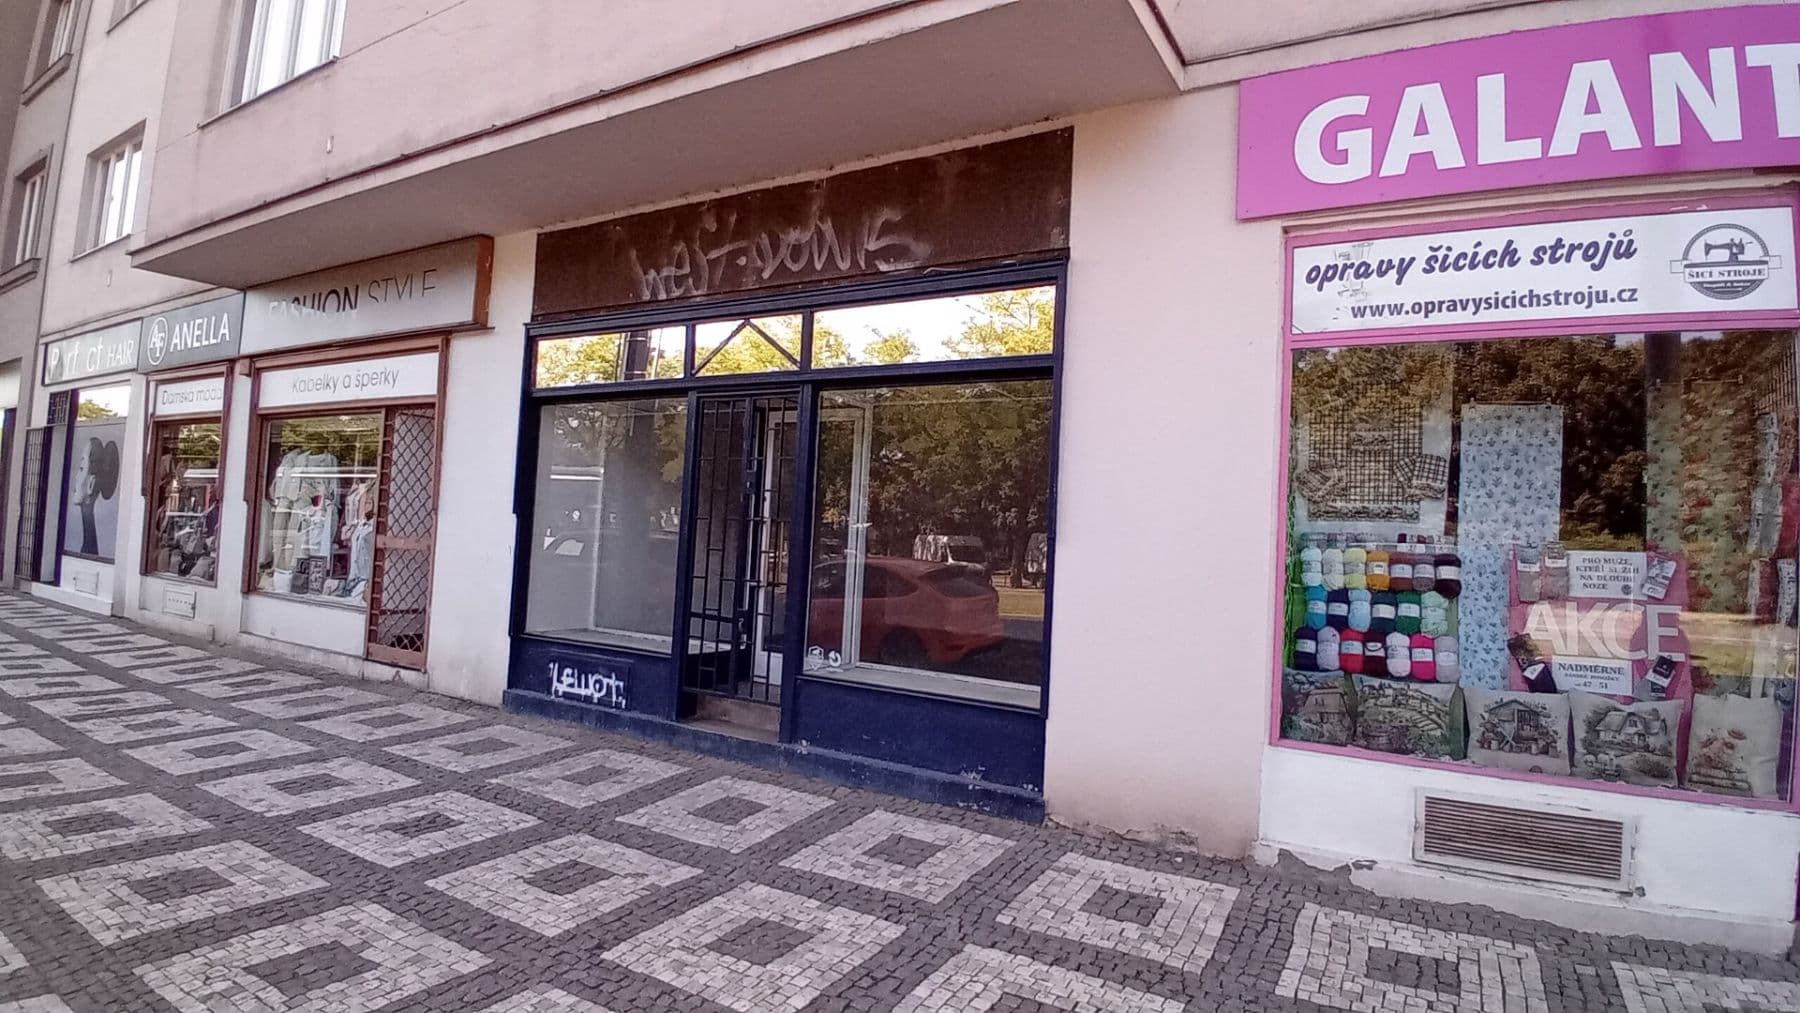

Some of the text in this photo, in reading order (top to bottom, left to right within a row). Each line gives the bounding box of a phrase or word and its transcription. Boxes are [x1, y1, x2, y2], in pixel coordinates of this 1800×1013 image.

[1293, 43, 1800, 184] GALANT
[1305, 228, 1638, 292] opravy šicích strojů
[1718, 267, 1766, 278] STROJE
[1350, 286, 1639, 320] www.opravysicichstroju.cz
[169, 312, 230, 353] ANELLA
[106, 339, 134, 369] HAIR
[342, 377, 351, 389] a
[354, 366, 400, 392] šperky
[1523, 601, 1686, 662] AKCE
